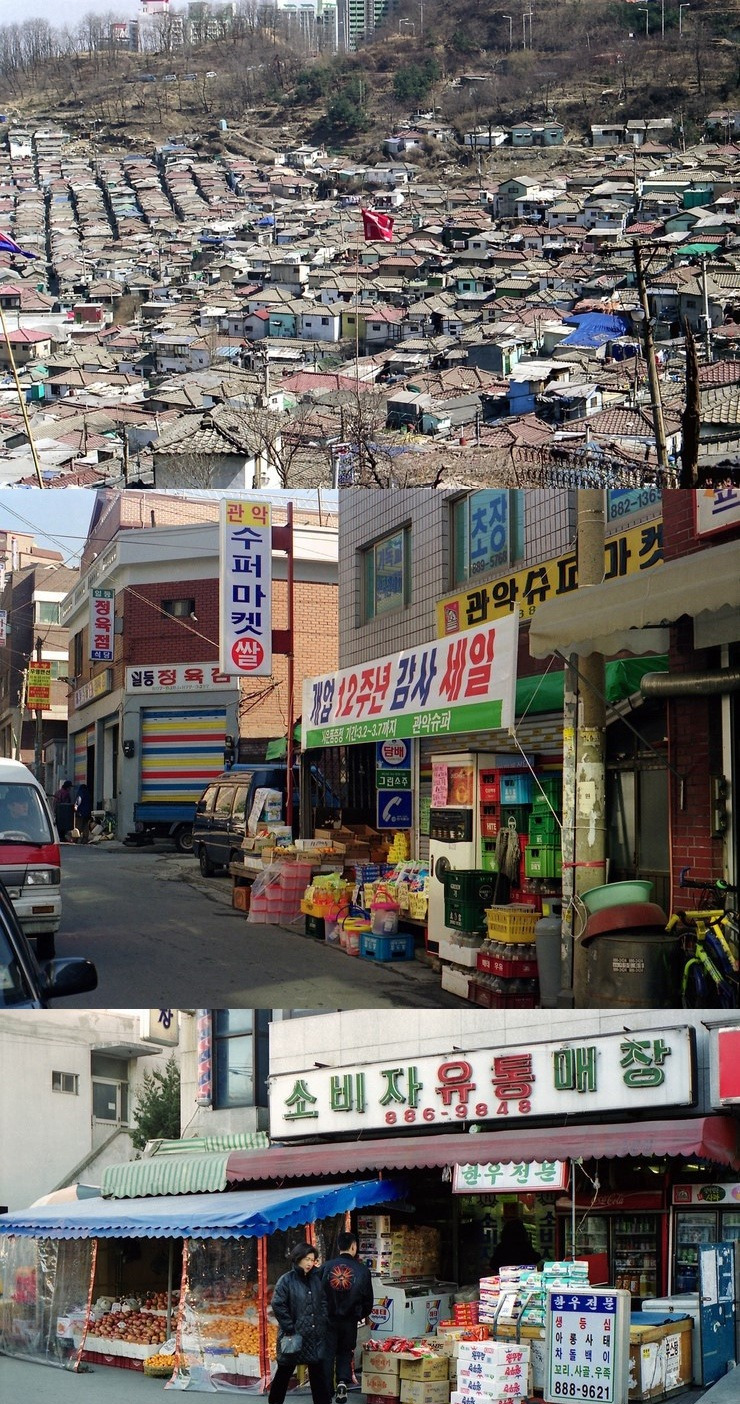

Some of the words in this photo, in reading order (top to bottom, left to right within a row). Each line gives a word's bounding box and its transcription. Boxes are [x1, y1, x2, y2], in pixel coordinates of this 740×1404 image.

[227, 503, 269, 525] 관악
[231, 527, 266, 635] 수퍼마켓
[94, 600, 112, 650] 정육점
[235, 641, 261, 667] 쌀
[310, 678, 335, 726] 개업
[335, 661, 392, 718] 12주년
[389, 647, 438, 711] 감사
[439, 628, 496, 702] 세일
[412, 710, 451, 735] 관악슈퍼
[384, 746, 404, 758] 담배
[378, 776, 408, 787] 그린소주
[384, 1099, 532, 1126] 886-9848
[461, 1160, 557, 1185] 한우전문
[554, 1295, 614, 1311] 한우전문
[555, 1381, 610, 1400] 888-9621
